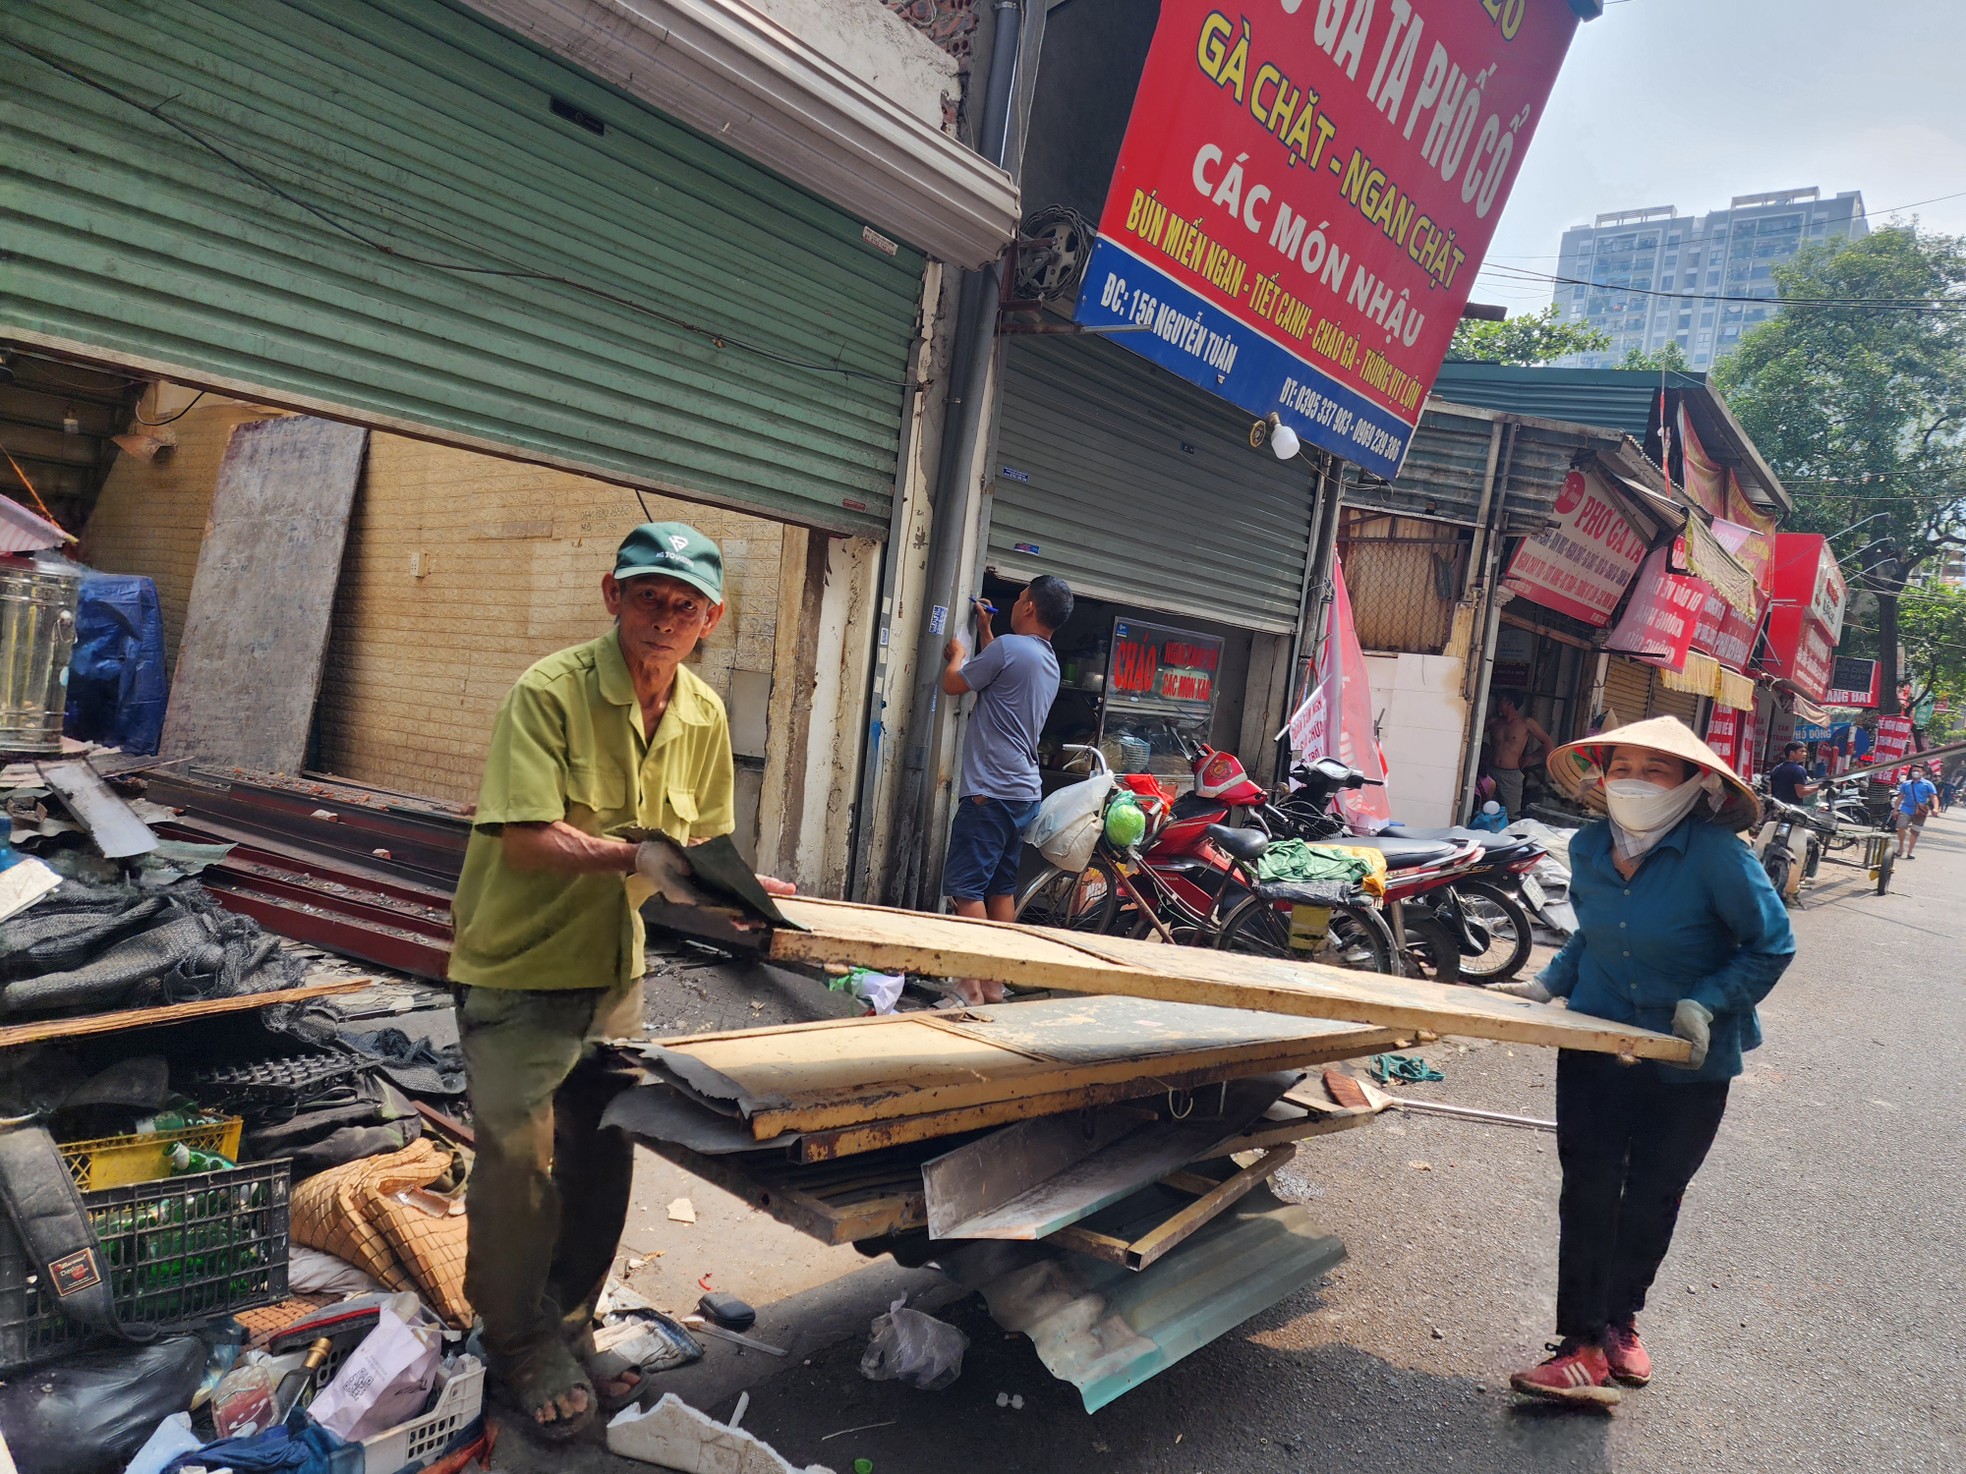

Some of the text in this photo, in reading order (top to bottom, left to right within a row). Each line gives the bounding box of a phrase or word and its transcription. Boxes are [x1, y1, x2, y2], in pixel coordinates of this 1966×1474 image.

[1197, 9, 1251, 108] GÀ
[1249, 61, 1337, 172] CHẶT
[1339, 147, 1417, 248] NGAN
[1407, 213, 1467, 292] CHẶT
[1403, 39, 1498, 182] PHỐ
[1461, 103, 1531, 219] CỔ
[1100, 271, 1239, 374] ĐC: 156 NGUYỄN TUÂN
[1125, 187, 1168, 247] BÚN
[1160, 213, 1209, 274] MIẾN
[1201, 240, 1248, 299] NGAN
[1248, 272, 1282, 321] TIẾT
[1274, 292, 1313, 341] CANH
[1311, 316, 1345, 362] CHÁO
[1339, 333, 1361, 372] GÀ
[1358, 347, 1393, 394] TRỨNG
[1387, 367, 1407, 405] VỊT
[1400, 375, 1423, 413] LỘN
[1192, 143, 1425, 348] CÁC MÓN NHẬU
[1279, 376, 1298, 409] ĐT:
[1294, 385, 1322, 420] 0395
[1316, 397, 1338, 427] 337
[1332, 406, 1353, 436] 983
[1352, 417, 1377, 449] 0969
[1371, 428, 1389, 457] 239
[1114, 630, 1157, 693] CHÁO
